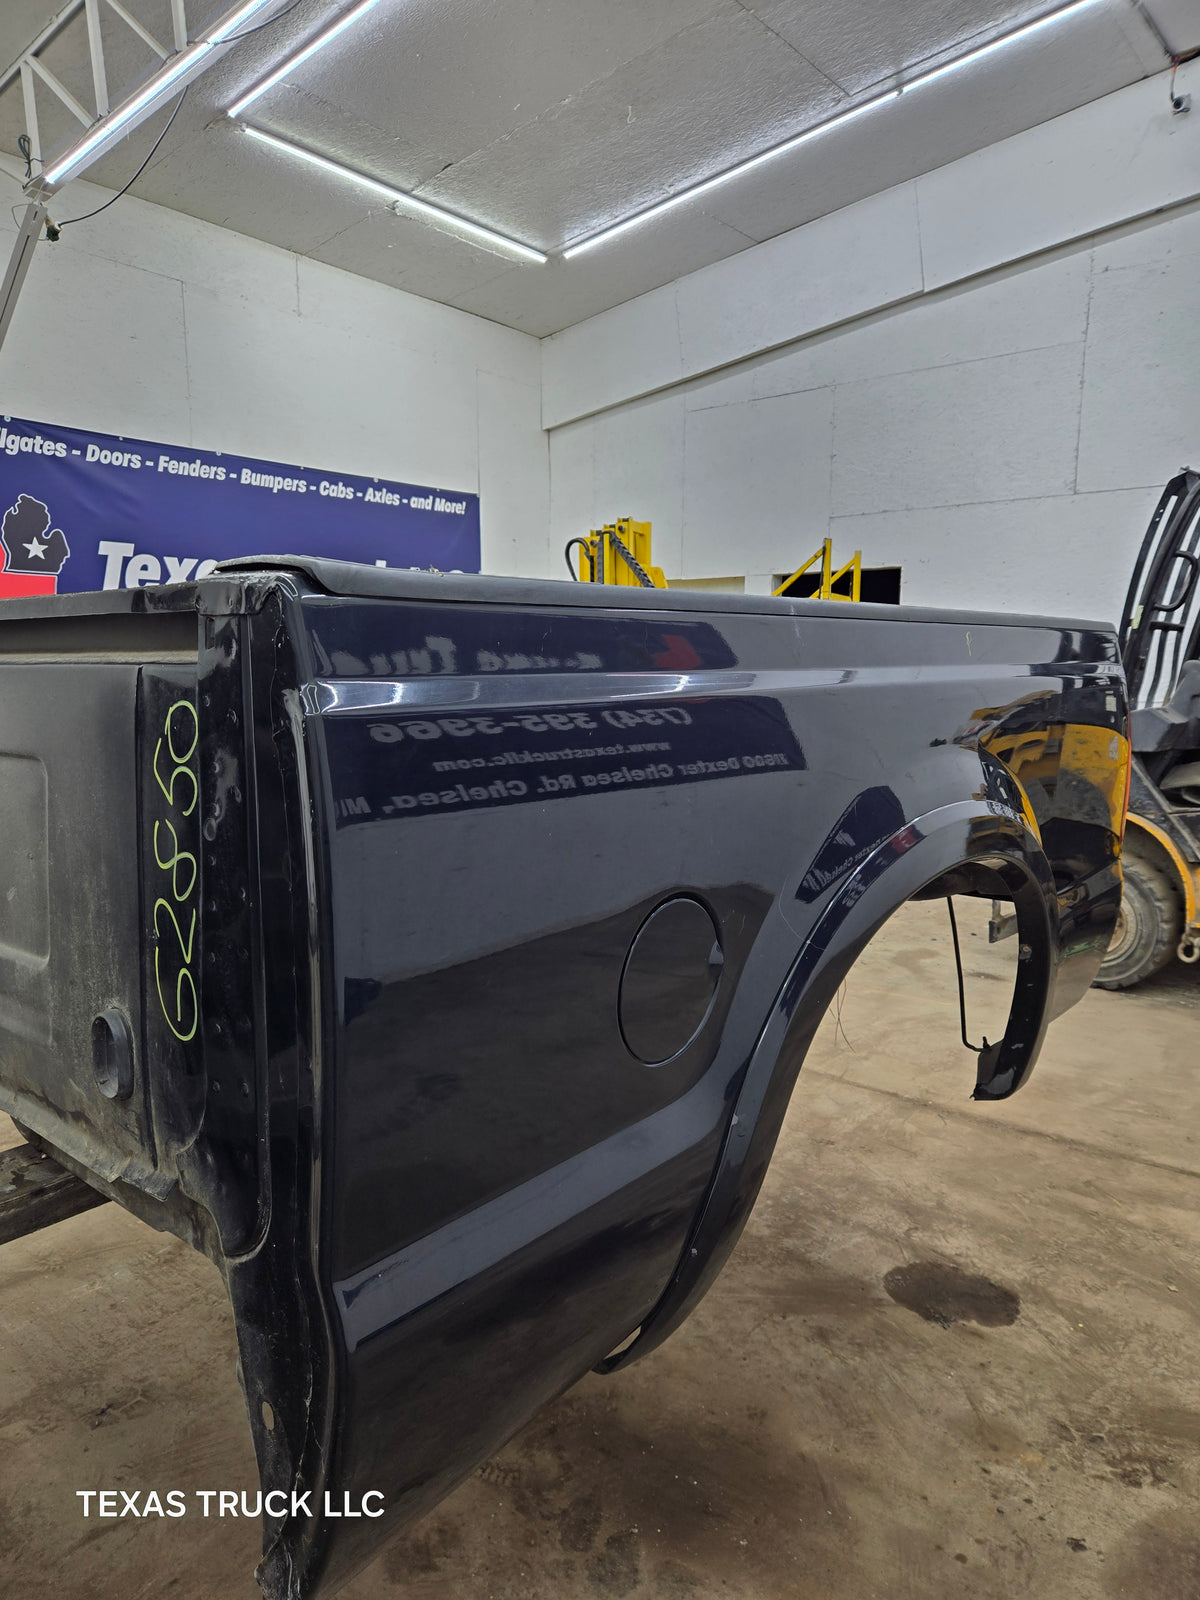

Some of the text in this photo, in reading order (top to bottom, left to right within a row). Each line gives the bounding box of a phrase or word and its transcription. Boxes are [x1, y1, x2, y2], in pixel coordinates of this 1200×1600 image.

[0, 428, 67, 458] lgates
[86, 444, 142, 469] Doors
[157, 455, 226, 481] Fenders
[240, 468, 307, 493] Bumpers
[319, 480, 354, 500] Cabs
[364, 487, 400, 506] Axles
[410, 495, 432, 511] and
[434, 497, 467, 515] More!
